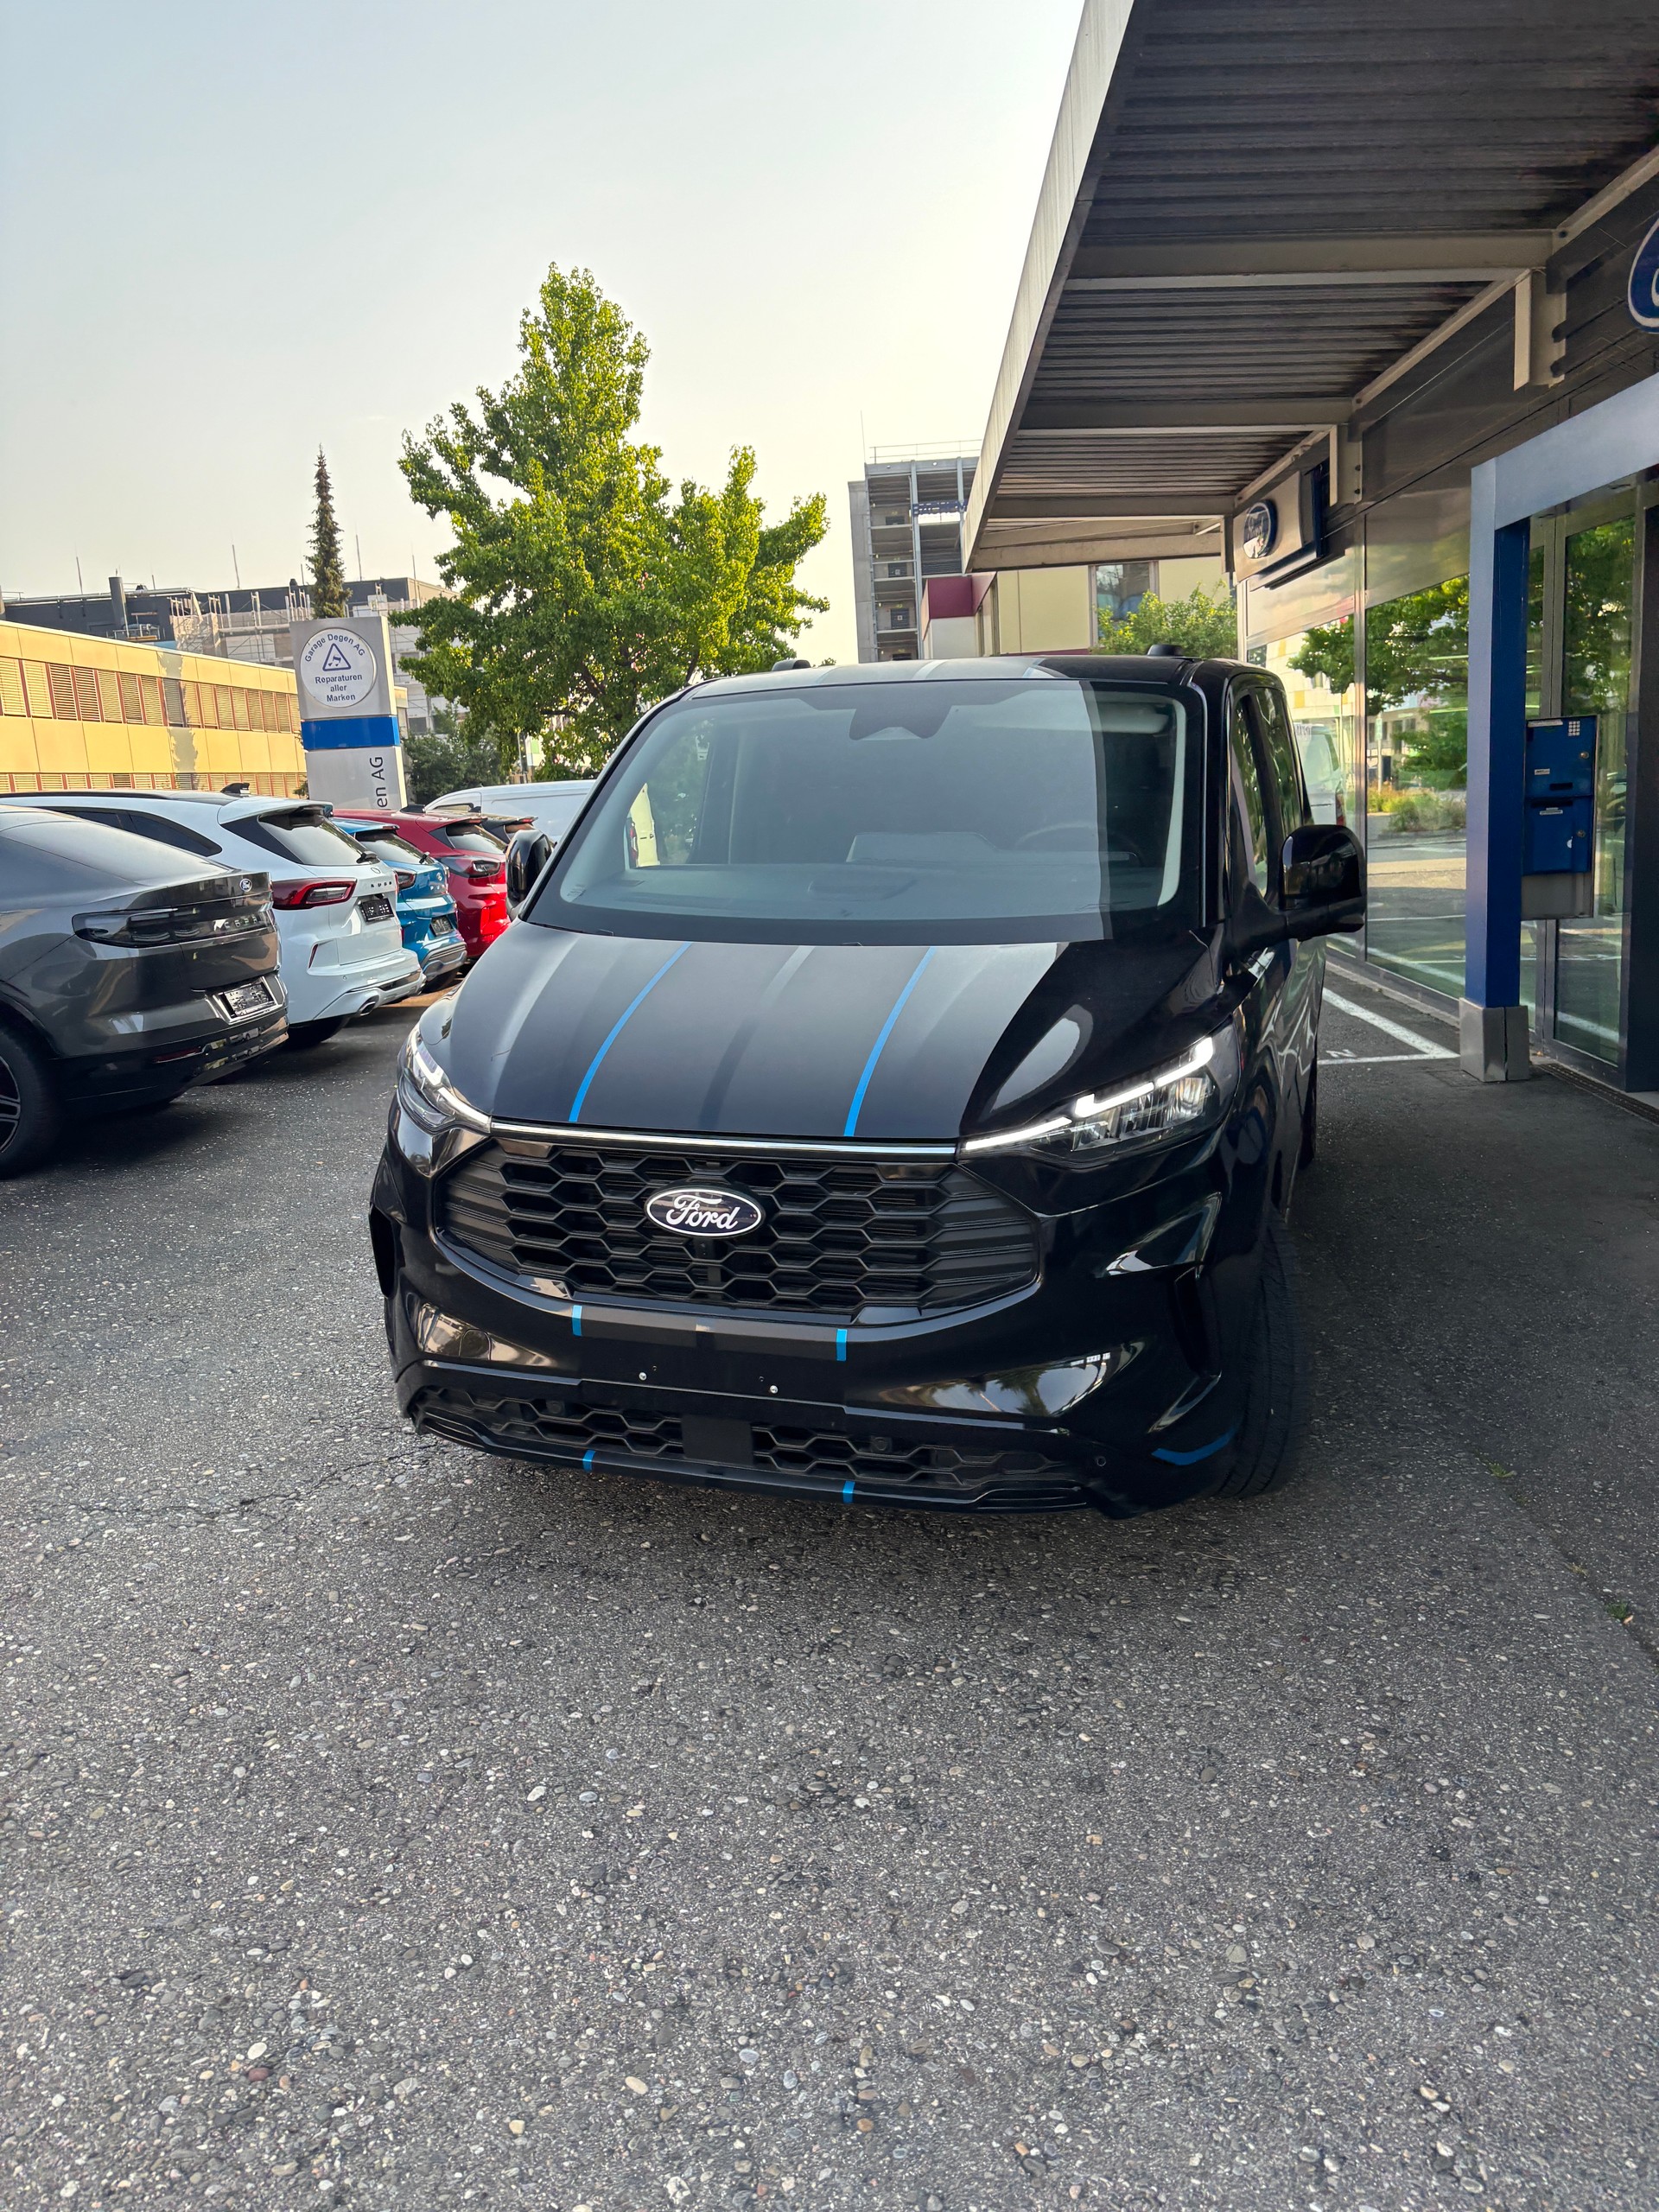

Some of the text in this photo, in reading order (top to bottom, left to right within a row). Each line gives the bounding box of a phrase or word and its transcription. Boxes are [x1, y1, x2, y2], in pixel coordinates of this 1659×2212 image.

[305, 634, 365, 662] Garage Degen AG
[315, 675, 362, 683] Reparaturen
[369, 757, 385, 780] AG
[665, 1194, 741, 1230] Ford
